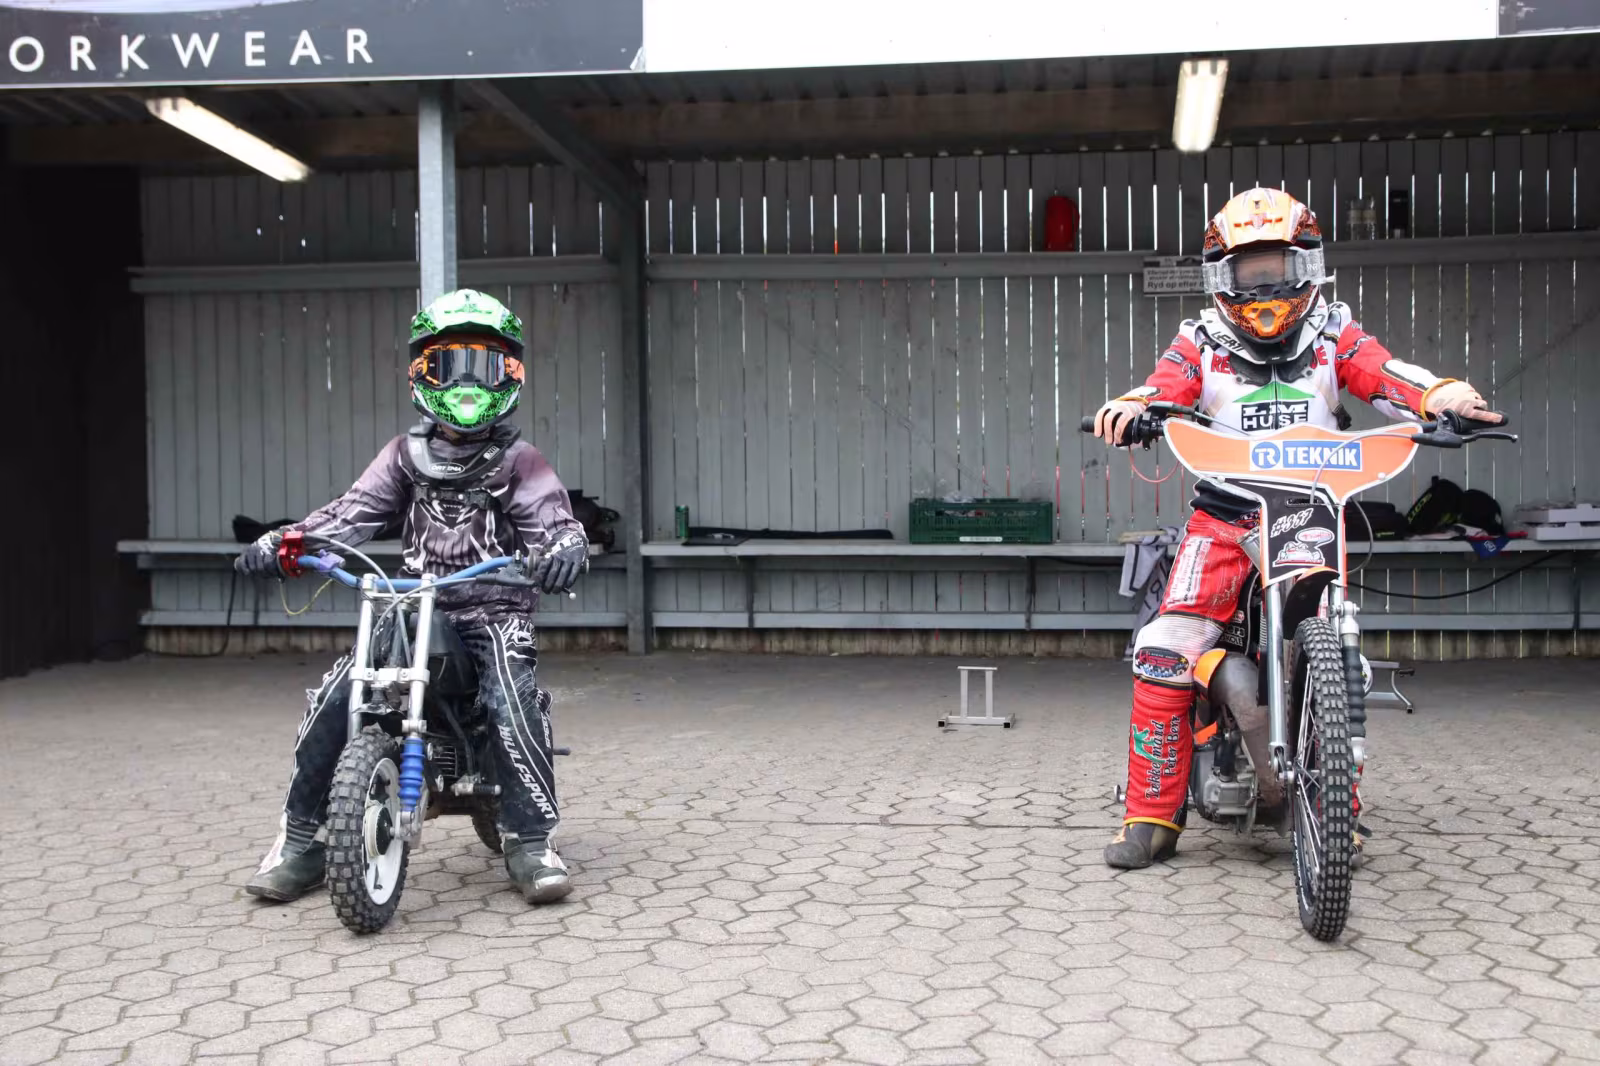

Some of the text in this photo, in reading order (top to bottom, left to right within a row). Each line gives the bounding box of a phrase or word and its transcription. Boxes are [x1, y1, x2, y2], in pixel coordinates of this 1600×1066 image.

[9, 28, 373, 72] ORKWEAR
[1147, 281, 1164, 289] Ryd
[1166, 282, 1177, 290] op
[1243, 414, 1308, 430] HUSE
[1255, 446, 1358, 467] TR TEKNIK
[498, 723, 558, 819] WULFSPORT
[1164, 746, 1178, 776] Peter
